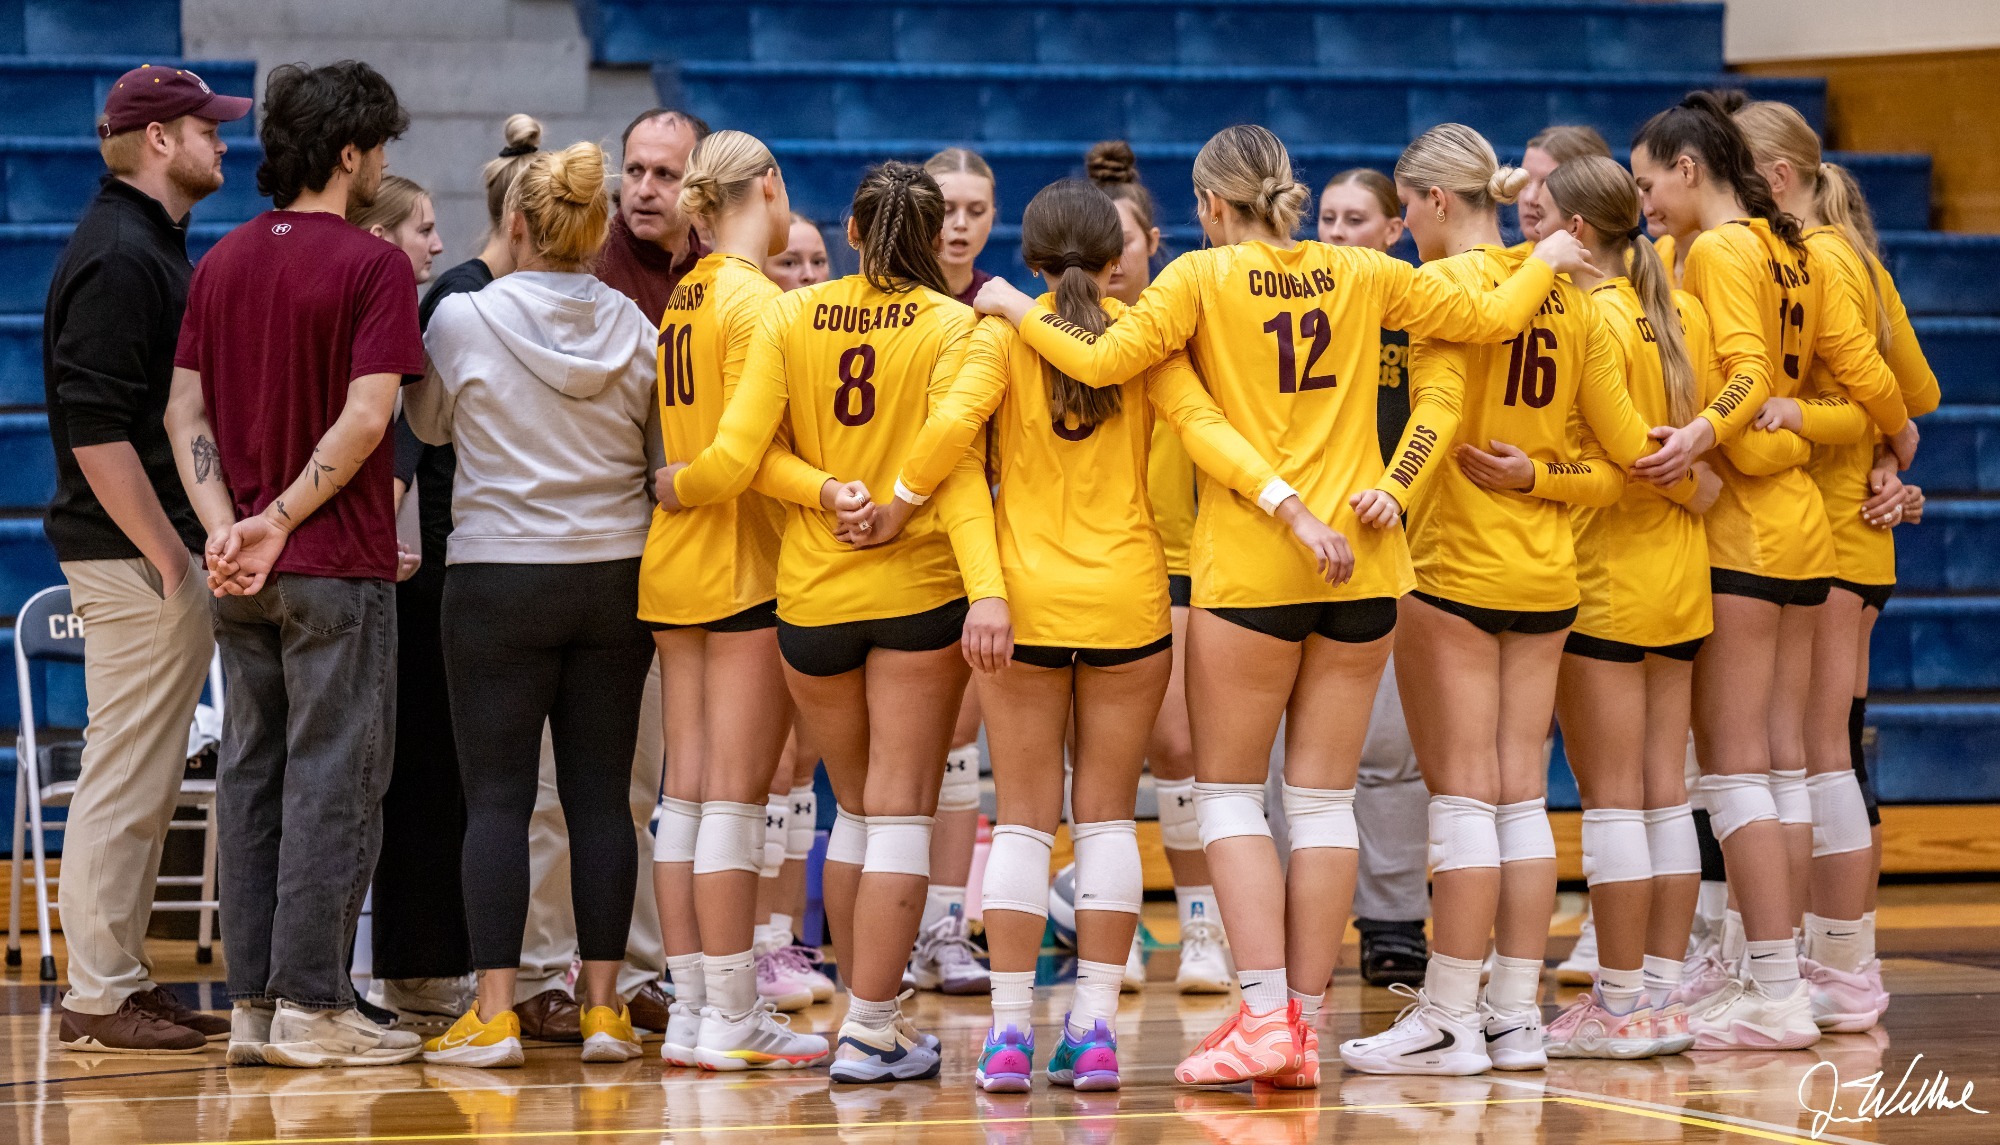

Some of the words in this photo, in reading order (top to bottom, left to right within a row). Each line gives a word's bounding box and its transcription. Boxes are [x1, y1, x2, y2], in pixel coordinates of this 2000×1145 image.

[1249, 267, 1336, 299] COUGARS
[813, 303, 918, 334] COUGARS
[1263, 308, 1337, 393] 12
[658, 323, 695, 406] 10
[834, 344, 875, 426] 8
[1502, 327, 1557, 408] 16
[1709, 373, 1754, 418] MORRIS
[1390, 424, 1437, 489] MORRIS
[49, 613, 84, 640] CA
